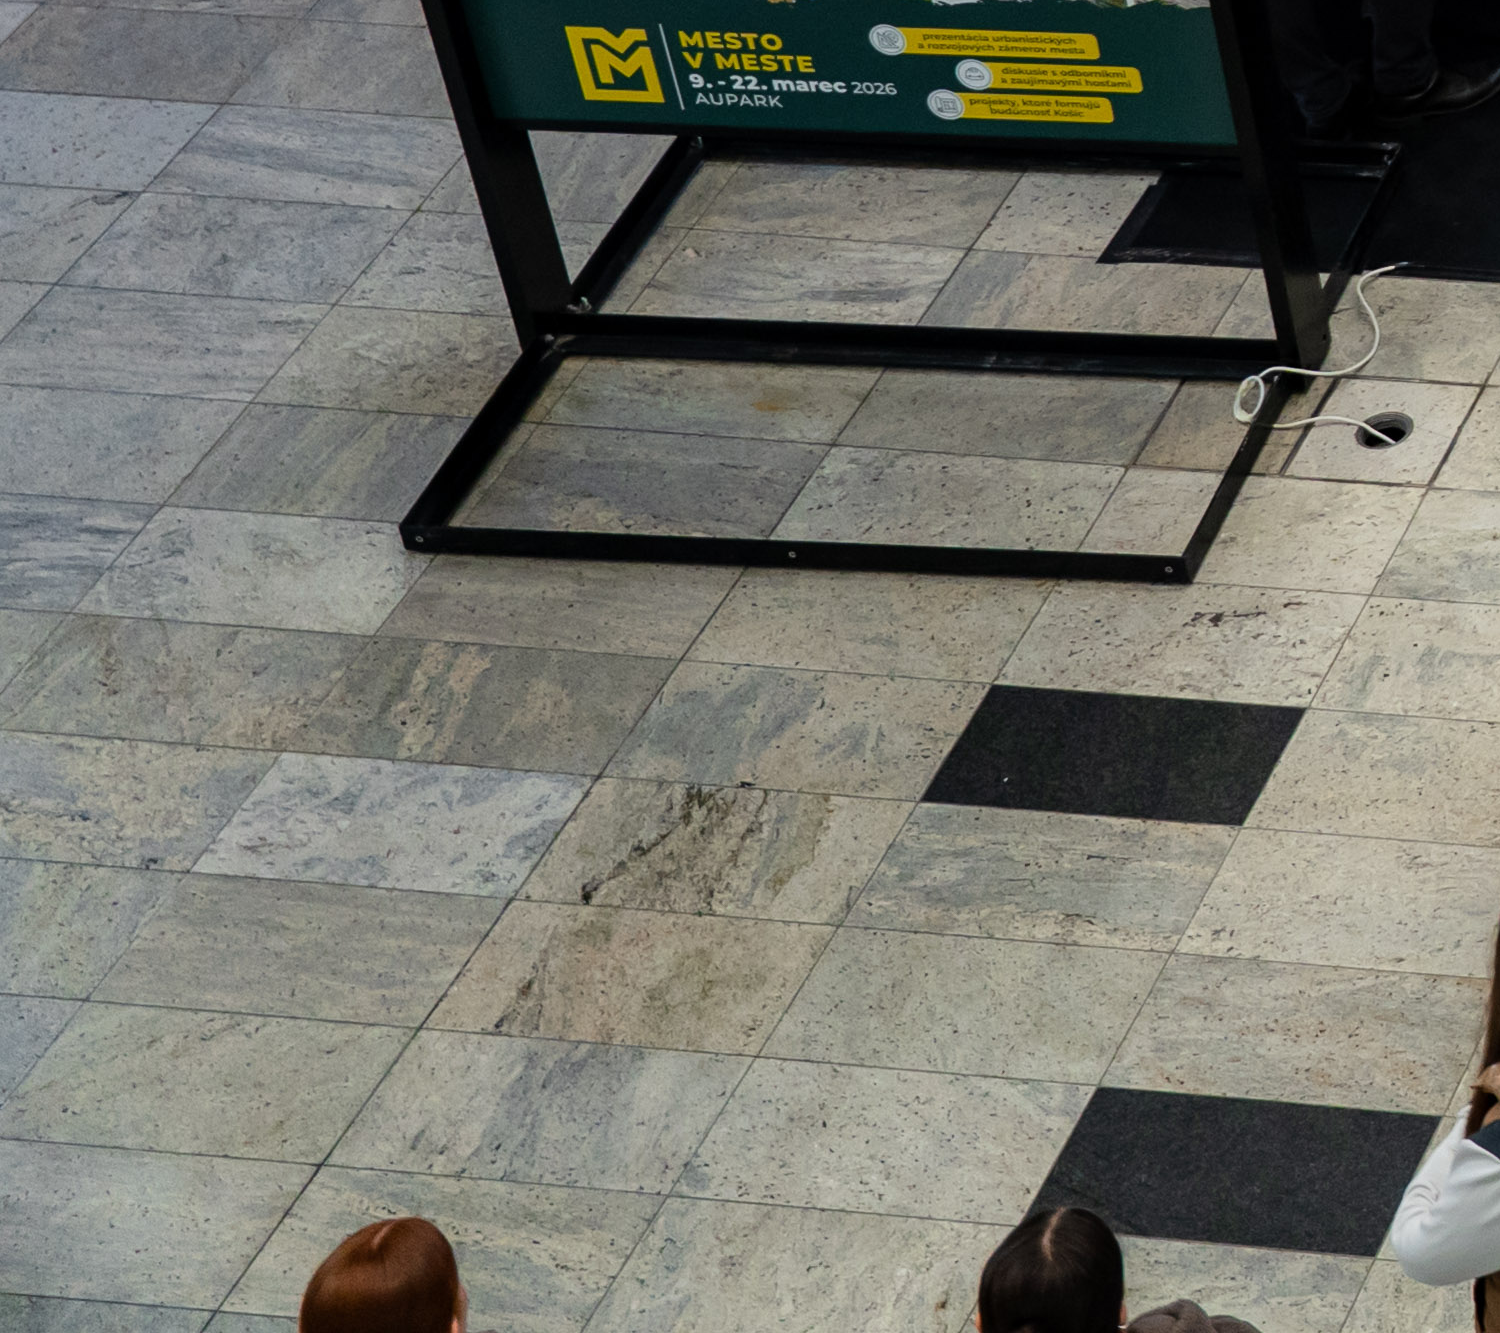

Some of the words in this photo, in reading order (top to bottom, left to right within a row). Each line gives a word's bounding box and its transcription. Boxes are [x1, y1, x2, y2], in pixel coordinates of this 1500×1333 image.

[678, 30, 784, 50] MESTO
[921, 32, 990, 43] prezentácia
[1050, 46, 1086, 55] mesta
[682, 51, 704, 69] V
[714, 52, 816, 73] MESTE
[1001, 66, 1048, 76] diskusie
[688, 73, 712, 90] 9.
[729, 75, 769, 91] 22.
[771, 78, 848, 94] marec
[850, 81, 898, 95] 2026
[695, 93, 784, 109] AUPARK
